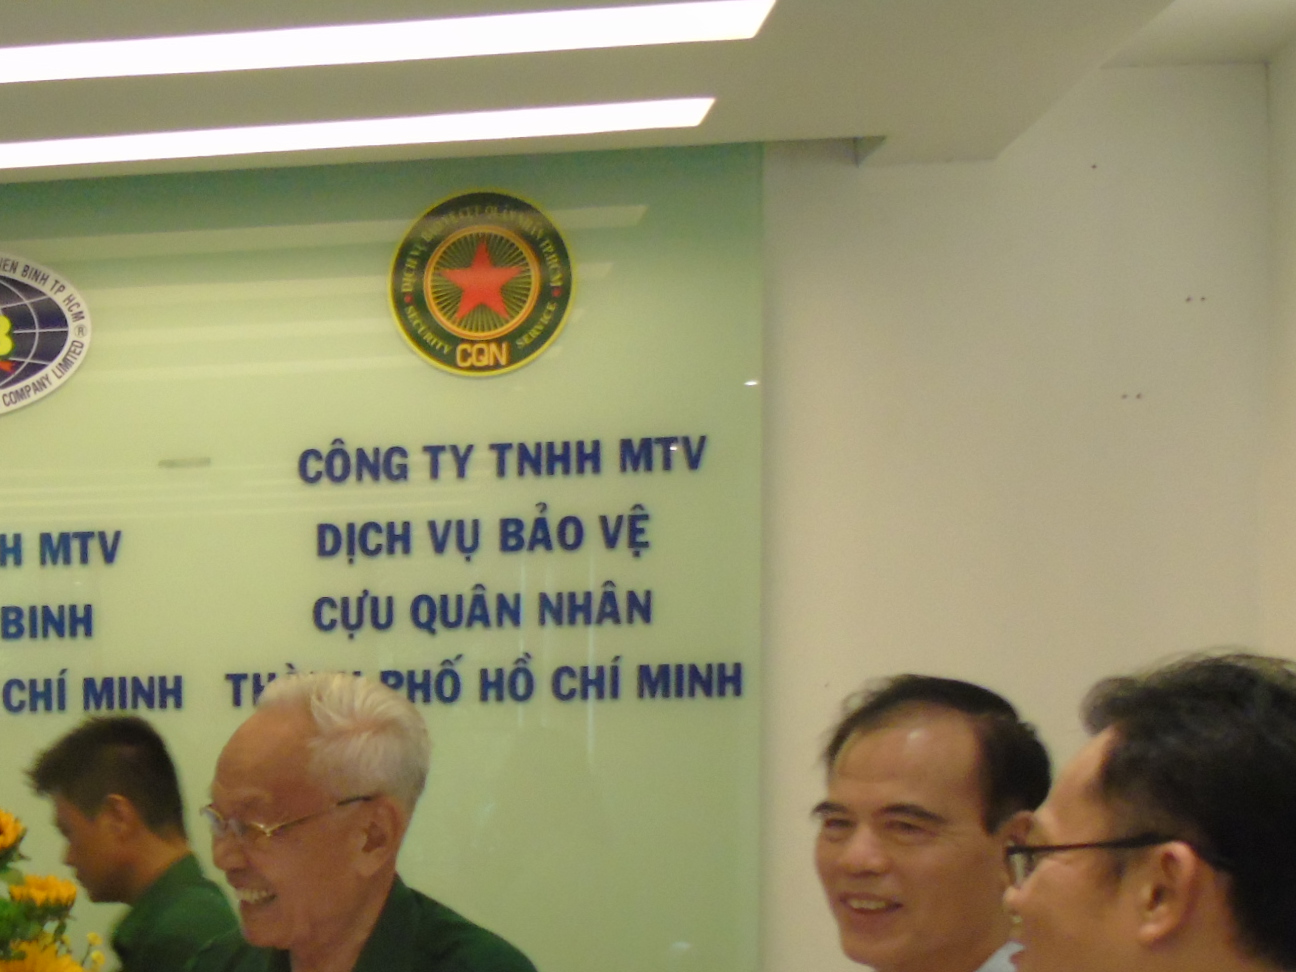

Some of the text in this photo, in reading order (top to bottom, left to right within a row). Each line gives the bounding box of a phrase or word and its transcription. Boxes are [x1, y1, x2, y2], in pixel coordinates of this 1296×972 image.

[21, 264, 50, 286] BINH
[50, 279, 66, 296] TP
[62, 293, 86, 323] HCM
[404, 304, 453, 355] SECURITY
[456, 342, 508, 367] CQN
[2, 373, 52, 407] COMPANY
[51, 340, 85, 380] LIMITED
[299, 434, 709, 485] CÔNG TY TNHH MTV
[39, 530, 122, 567] MTV
[317, 501, 652, 565] DỊCH VỤ BẢO VỆ
[0, 603, 94, 642] BINH
[314, 579, 654, 639] CỰU QUÂN NHÂN
[2, 671, 68, 716] CHÍ
[82, 674, 184, 712] MINH
[380, 653, 464, 705] PHỐ
[480, 652, 537, 705] HỒ
[551, 655, 623, 704] CHÍ
[637, 661, 746, 701] MINH
